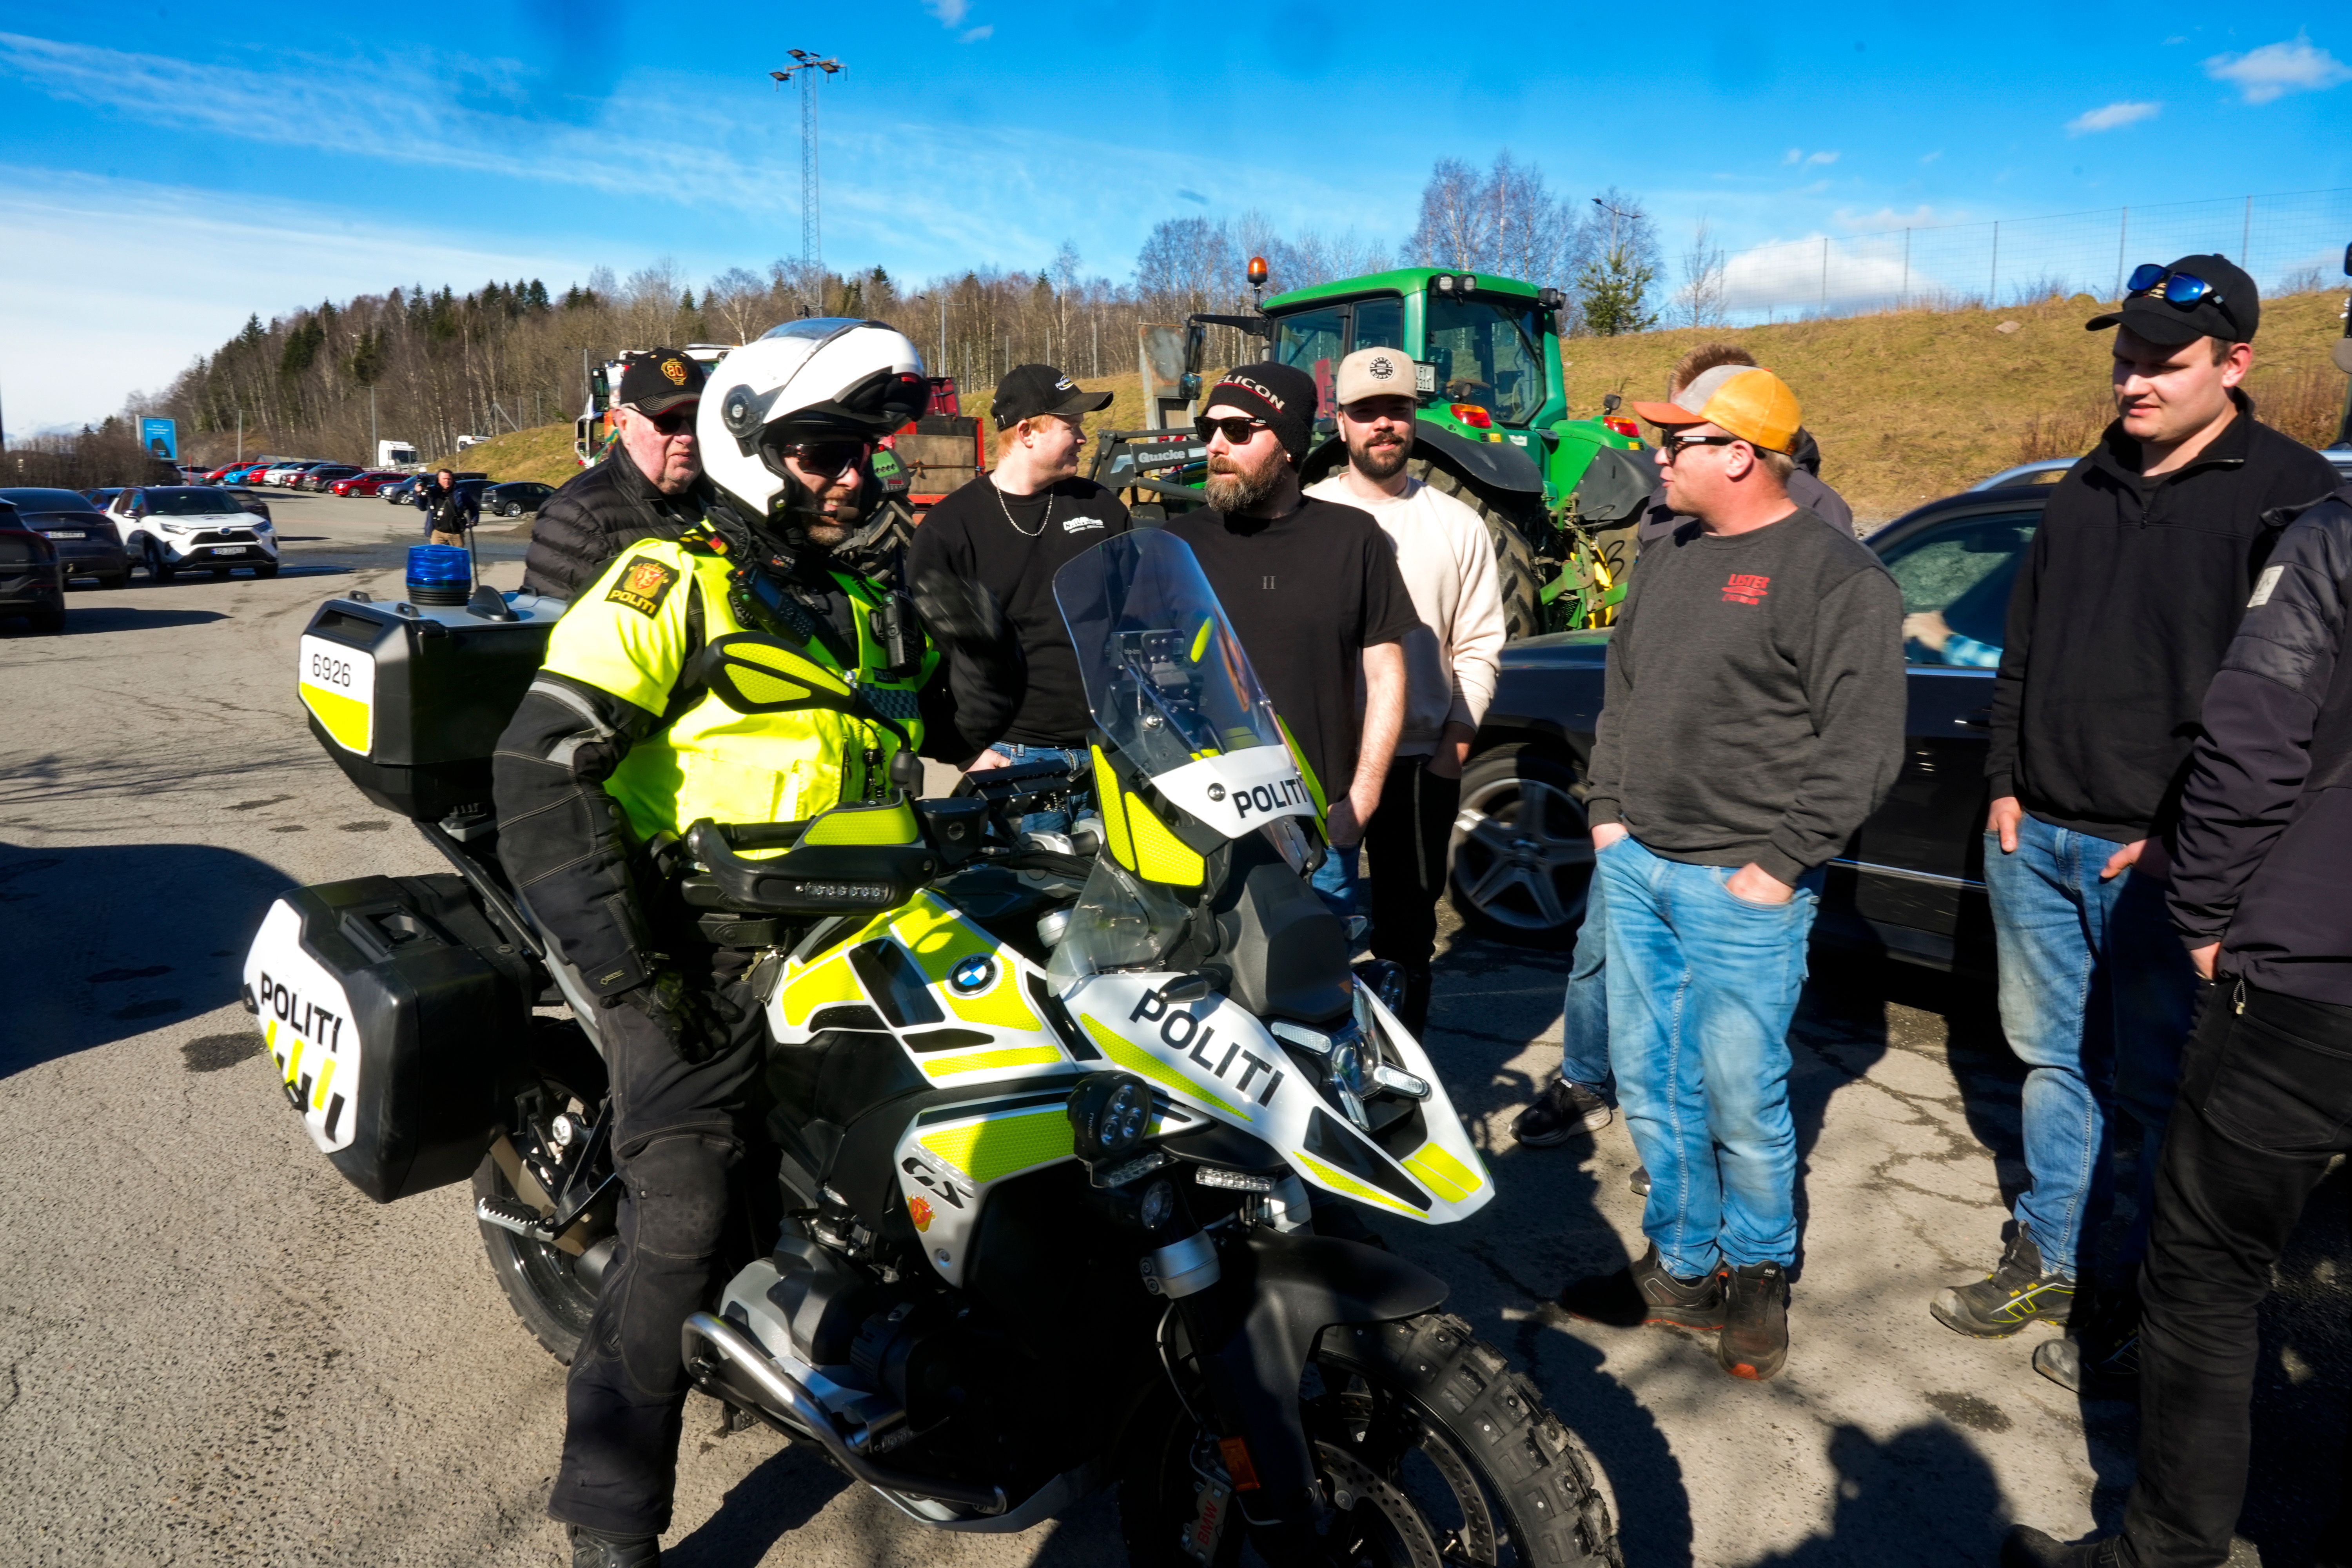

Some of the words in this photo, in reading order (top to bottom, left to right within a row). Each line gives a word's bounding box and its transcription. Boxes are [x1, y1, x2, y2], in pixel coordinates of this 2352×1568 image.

[1371, 370, 1392, 379] SUPPLY
[1138, 449, 1186, 463] Quicke
[608, 590, 657, 614] POLITI
[313, 653, 351, 687] 6926
[1232, 779, 1308, 818] POLITI
[261, 971, 343, 1054] POLITI
[1129, 988, 1285, 1108] POLITI
[902, 1157, 975, 1209] GS
[1198, 1499, 1218, 1545] BMW
